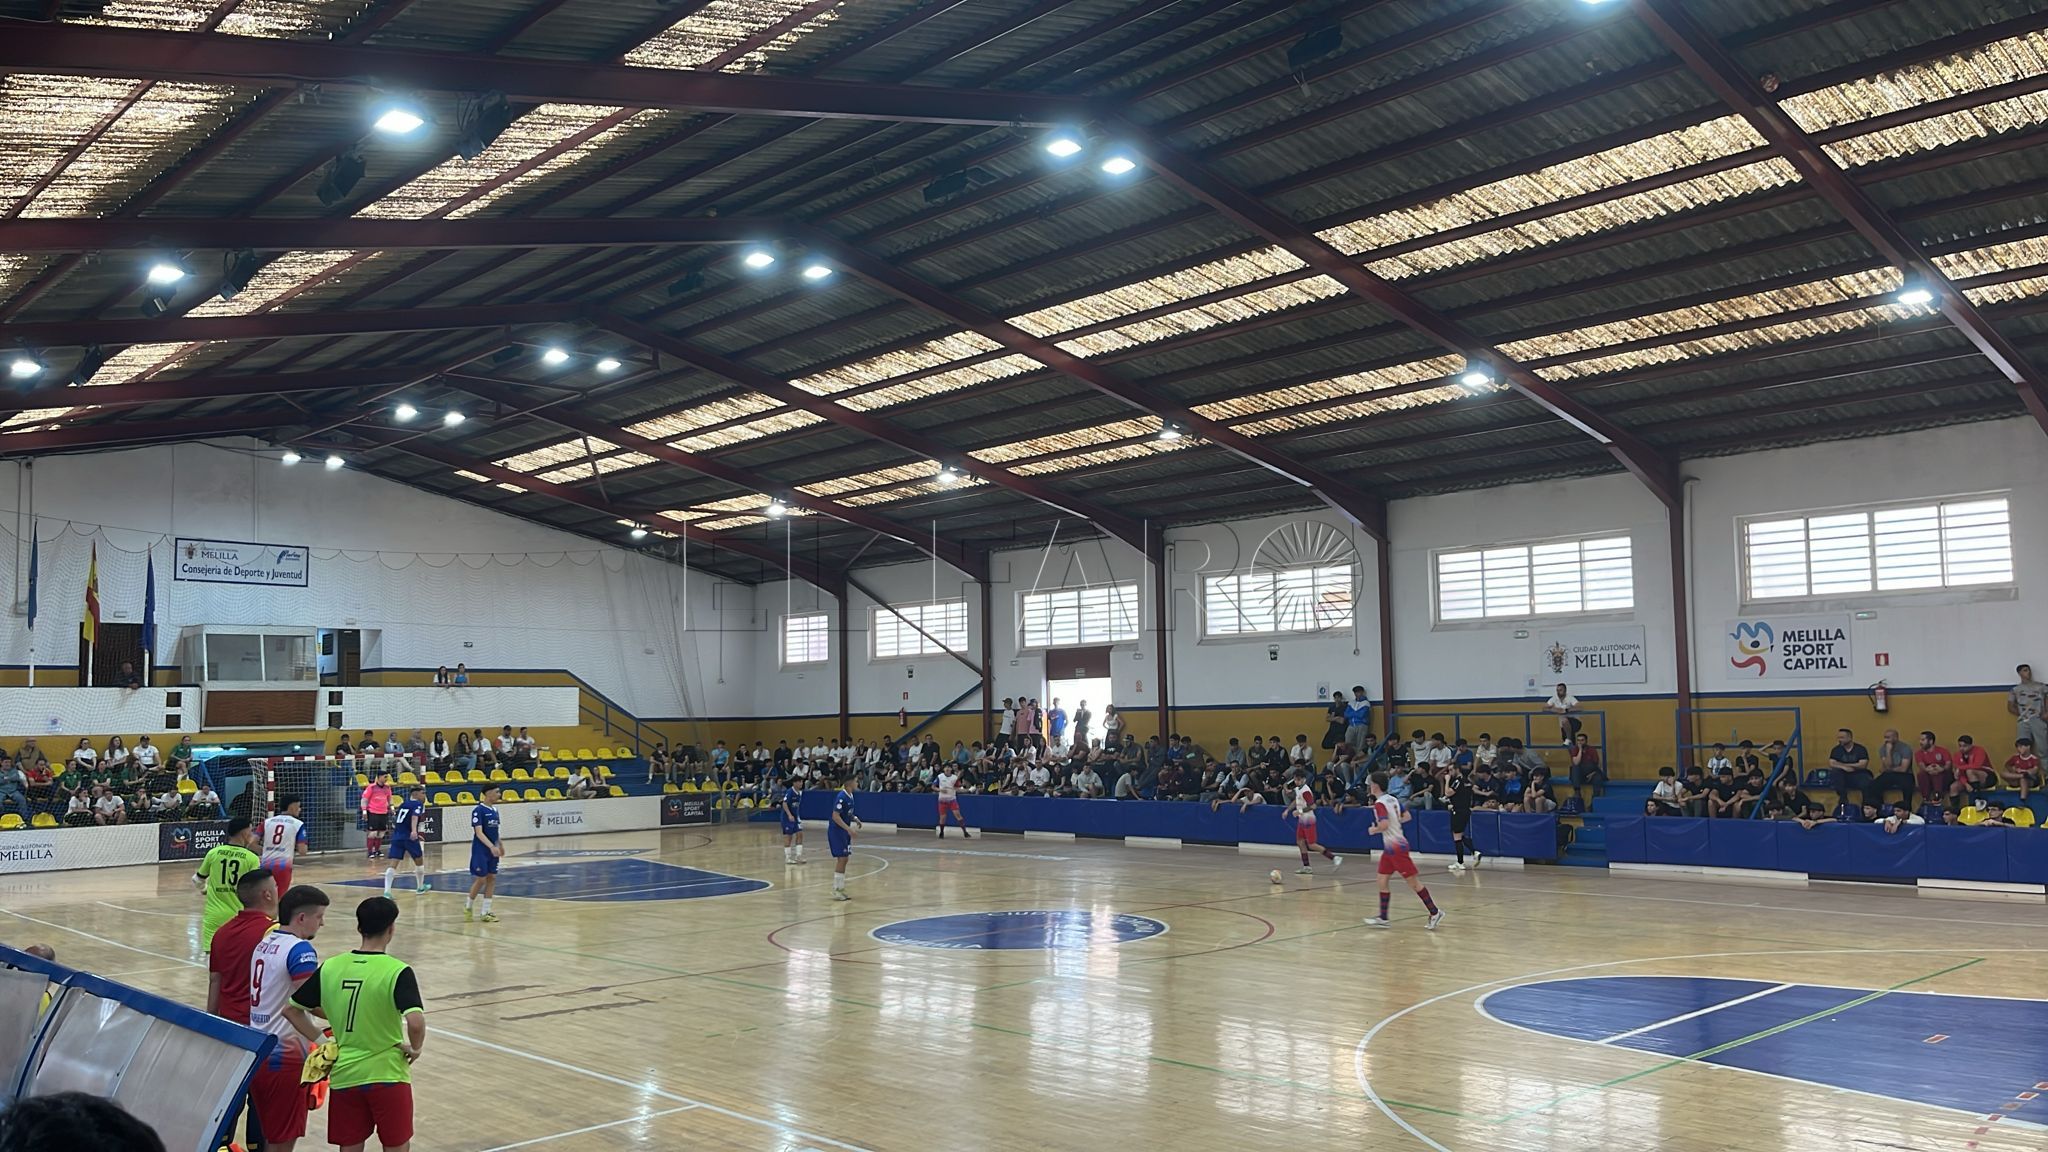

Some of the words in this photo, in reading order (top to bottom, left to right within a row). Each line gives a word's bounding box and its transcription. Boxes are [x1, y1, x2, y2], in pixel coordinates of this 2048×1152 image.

[201, 550, 239, 560] MELILLA
[223, 566, 232, 576] de
[234, 566, 265, 579] Deporte
[266, 571, 270, 580] y
[272, 569, 303, 580] Juventud
[1782, 628, 1846, 643] MELILLA
[1573, 645, 1598, 653] CIUDAD
[1783, 643, 1834, 657] SPORT
[1575, 652, 1642, 669] MELILLA
[1783, 657, 1848, 670] CAPITAL
[547, 815, 583, 825] MELILLA
[272, 824, 285, 845] 8
[0, 850, 53, 861] MELILLA
[220, 858, 240, 886] 13
[251, 958, 265, 1007] 9
[342, 980, 364, 1032] 7
